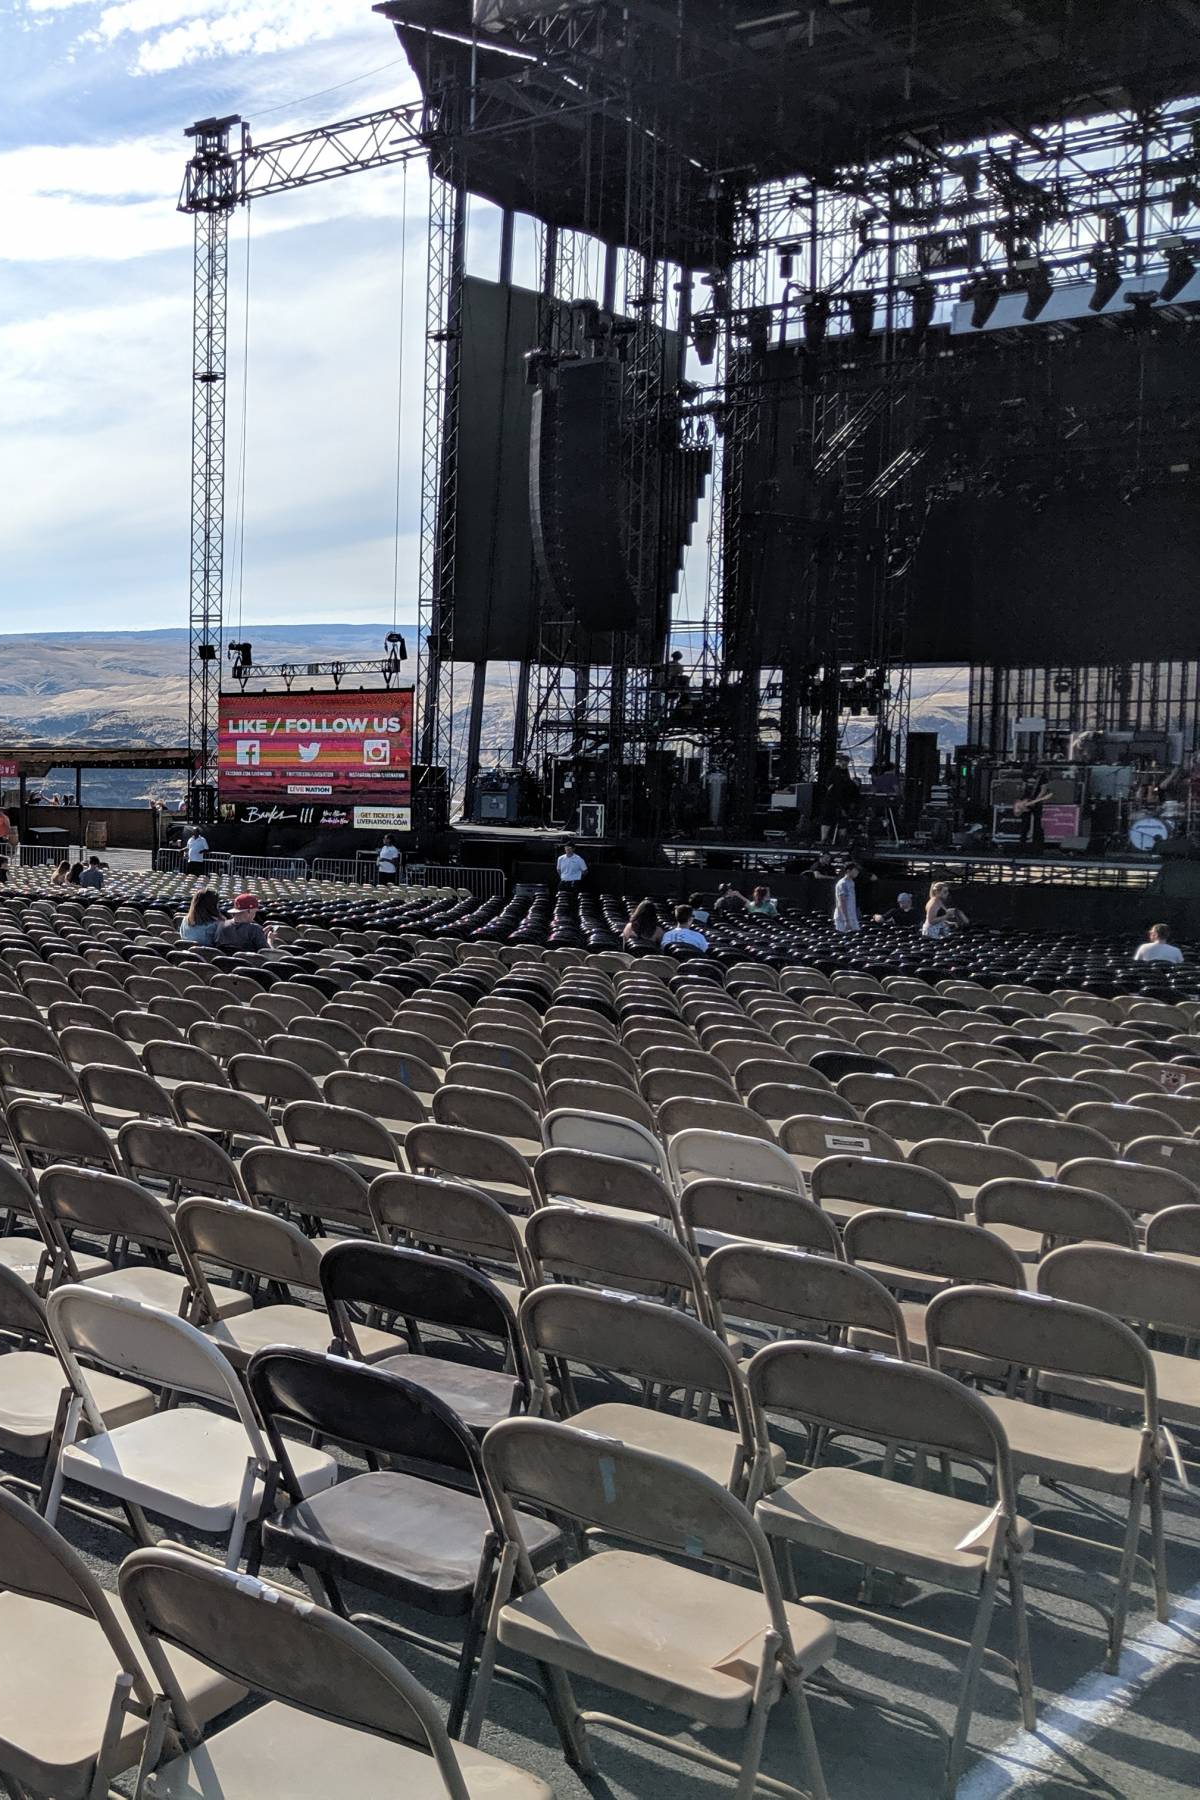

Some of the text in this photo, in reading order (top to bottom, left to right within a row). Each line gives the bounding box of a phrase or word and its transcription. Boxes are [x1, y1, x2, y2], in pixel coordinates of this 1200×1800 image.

[228, 717, 401, 736] LIKE / FOLLOW US
